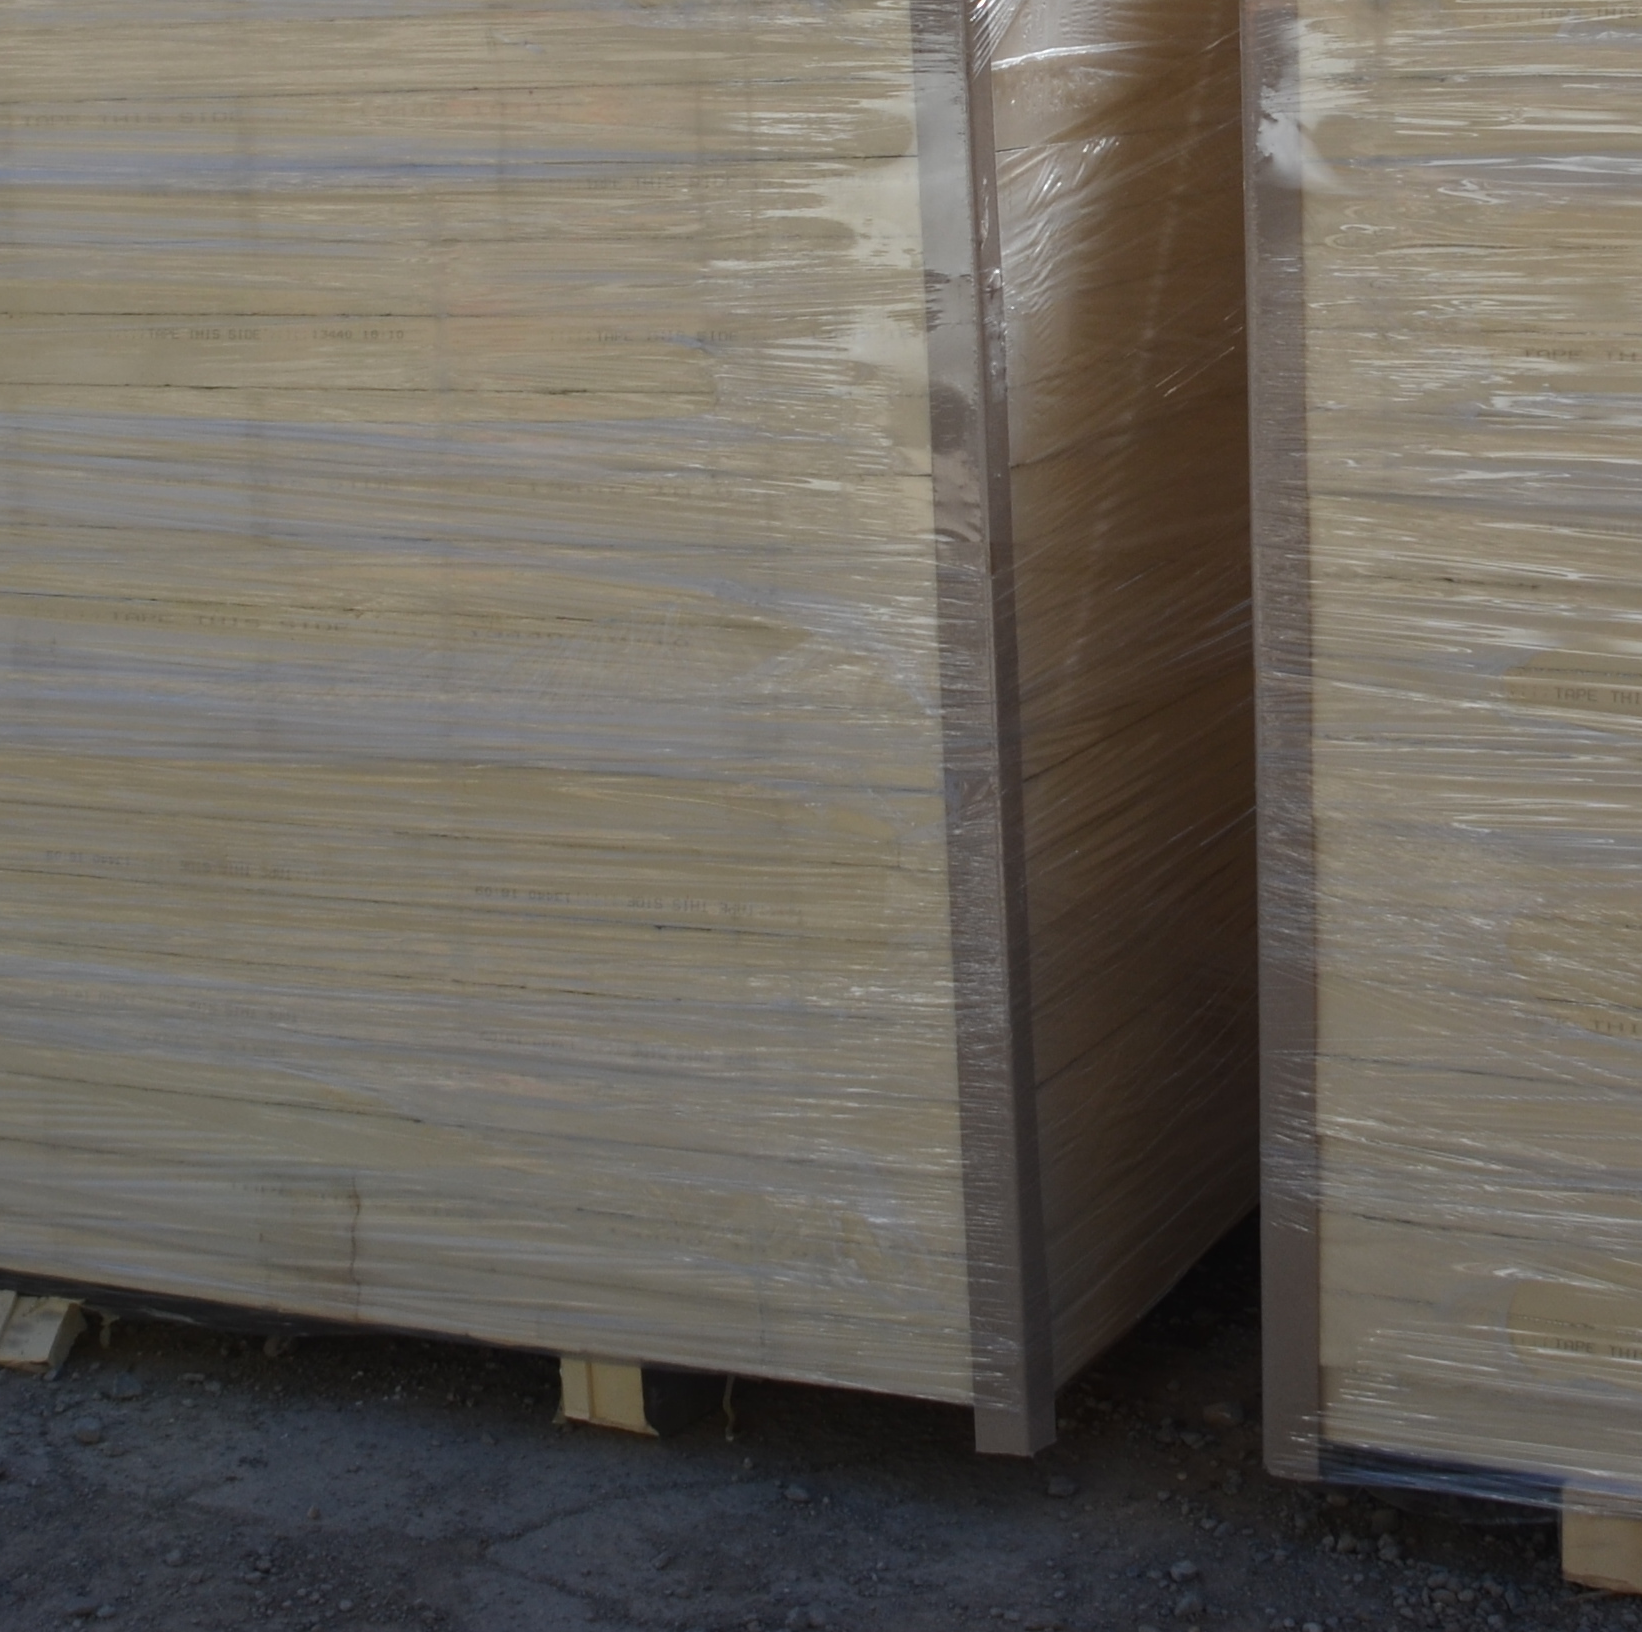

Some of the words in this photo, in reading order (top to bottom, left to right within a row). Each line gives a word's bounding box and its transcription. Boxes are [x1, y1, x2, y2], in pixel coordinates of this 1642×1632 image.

[148, 328, 180, 340] TAPE
[190, 328, 220, 340] THIS
[228, 328, 261, 340] SIDE
[312, 329, 352, 340] 13440
[363, 329, 405, 340] 18:10
[1554, 687, 1597, 703] TAPE
[1555, 1338, 1595, 1355] TAPE
